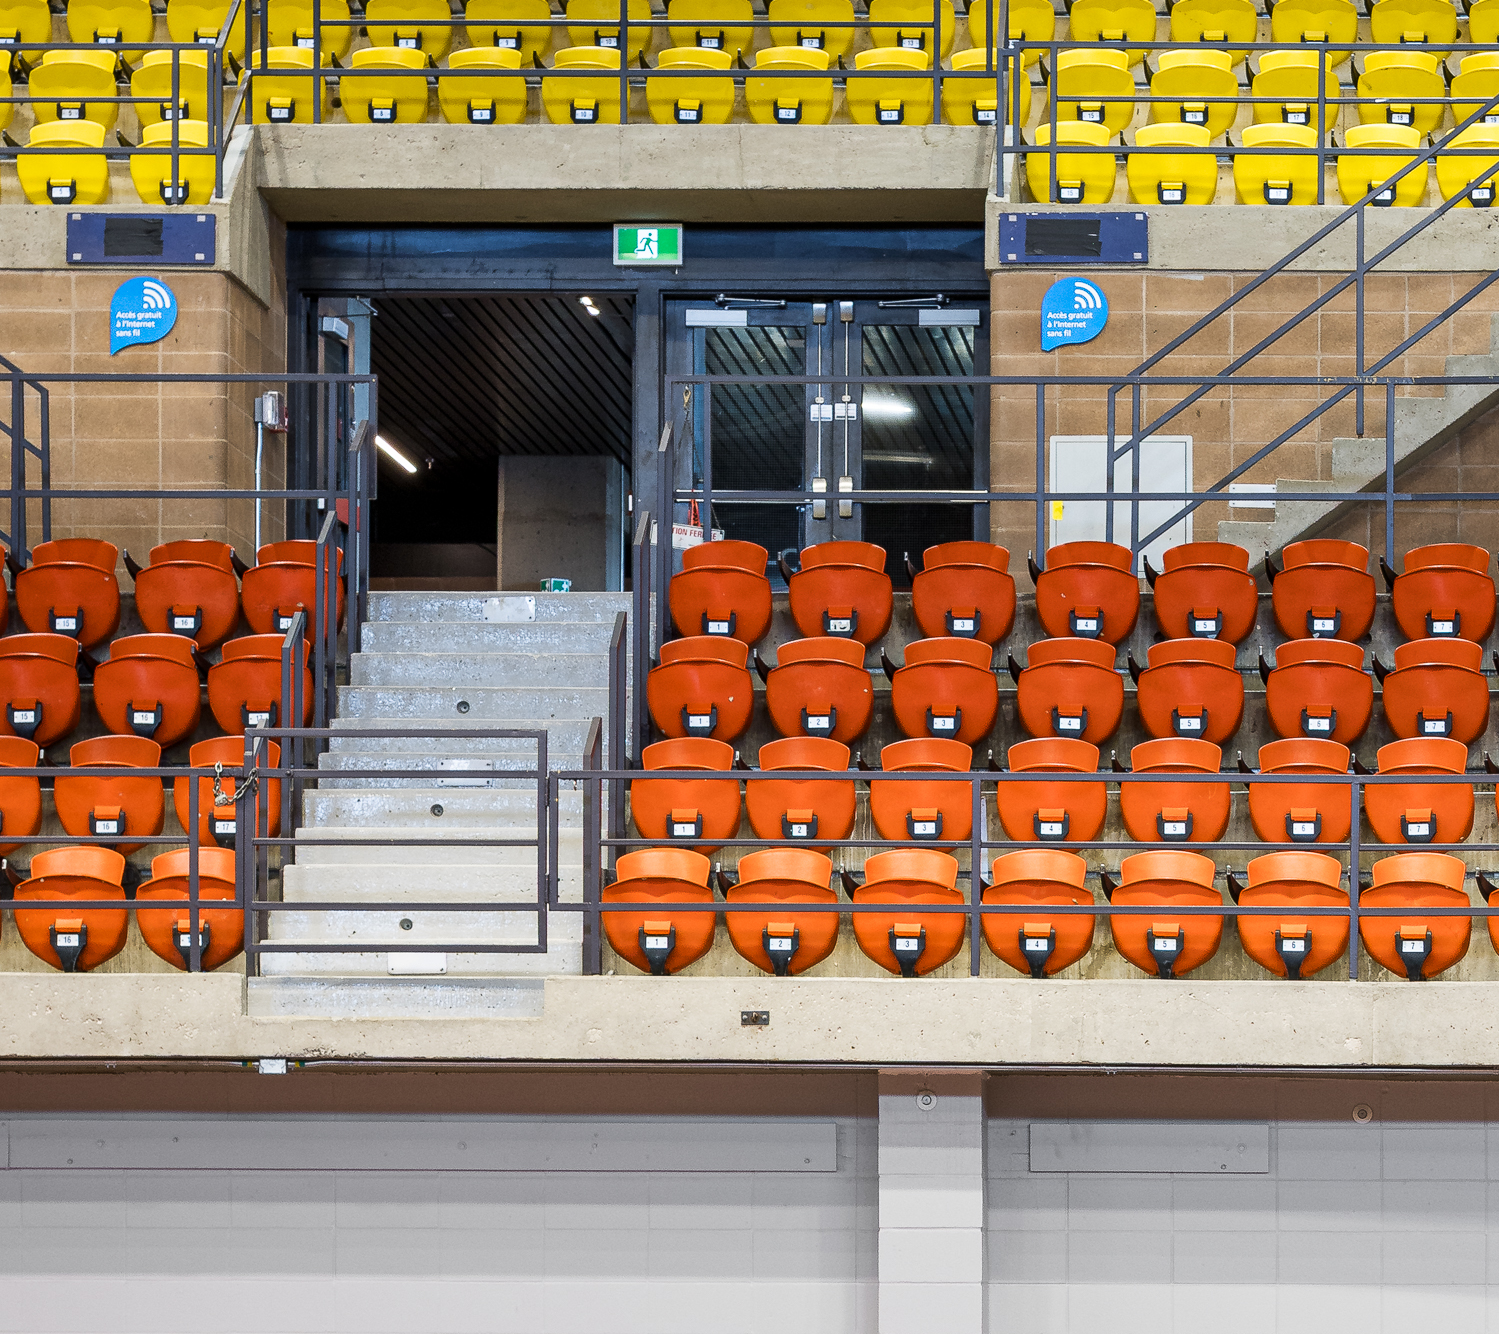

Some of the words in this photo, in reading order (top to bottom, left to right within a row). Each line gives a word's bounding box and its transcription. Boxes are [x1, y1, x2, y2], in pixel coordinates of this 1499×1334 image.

[116, 311, 136, 319] Accès
[137, 311, 162, 320] gratuit
[1047, 311, 1067, 319] Accès
[1068, 311, 1093, 320] gratuit
[62, 619, 70, 628] 15
[21, 712, 29, 721] 15
[141, 713, 149, 721] 16
[102, 822, 110, 831] 16
[222, 823, 230, 831] 17
[64, 935, 72, 944] 16
